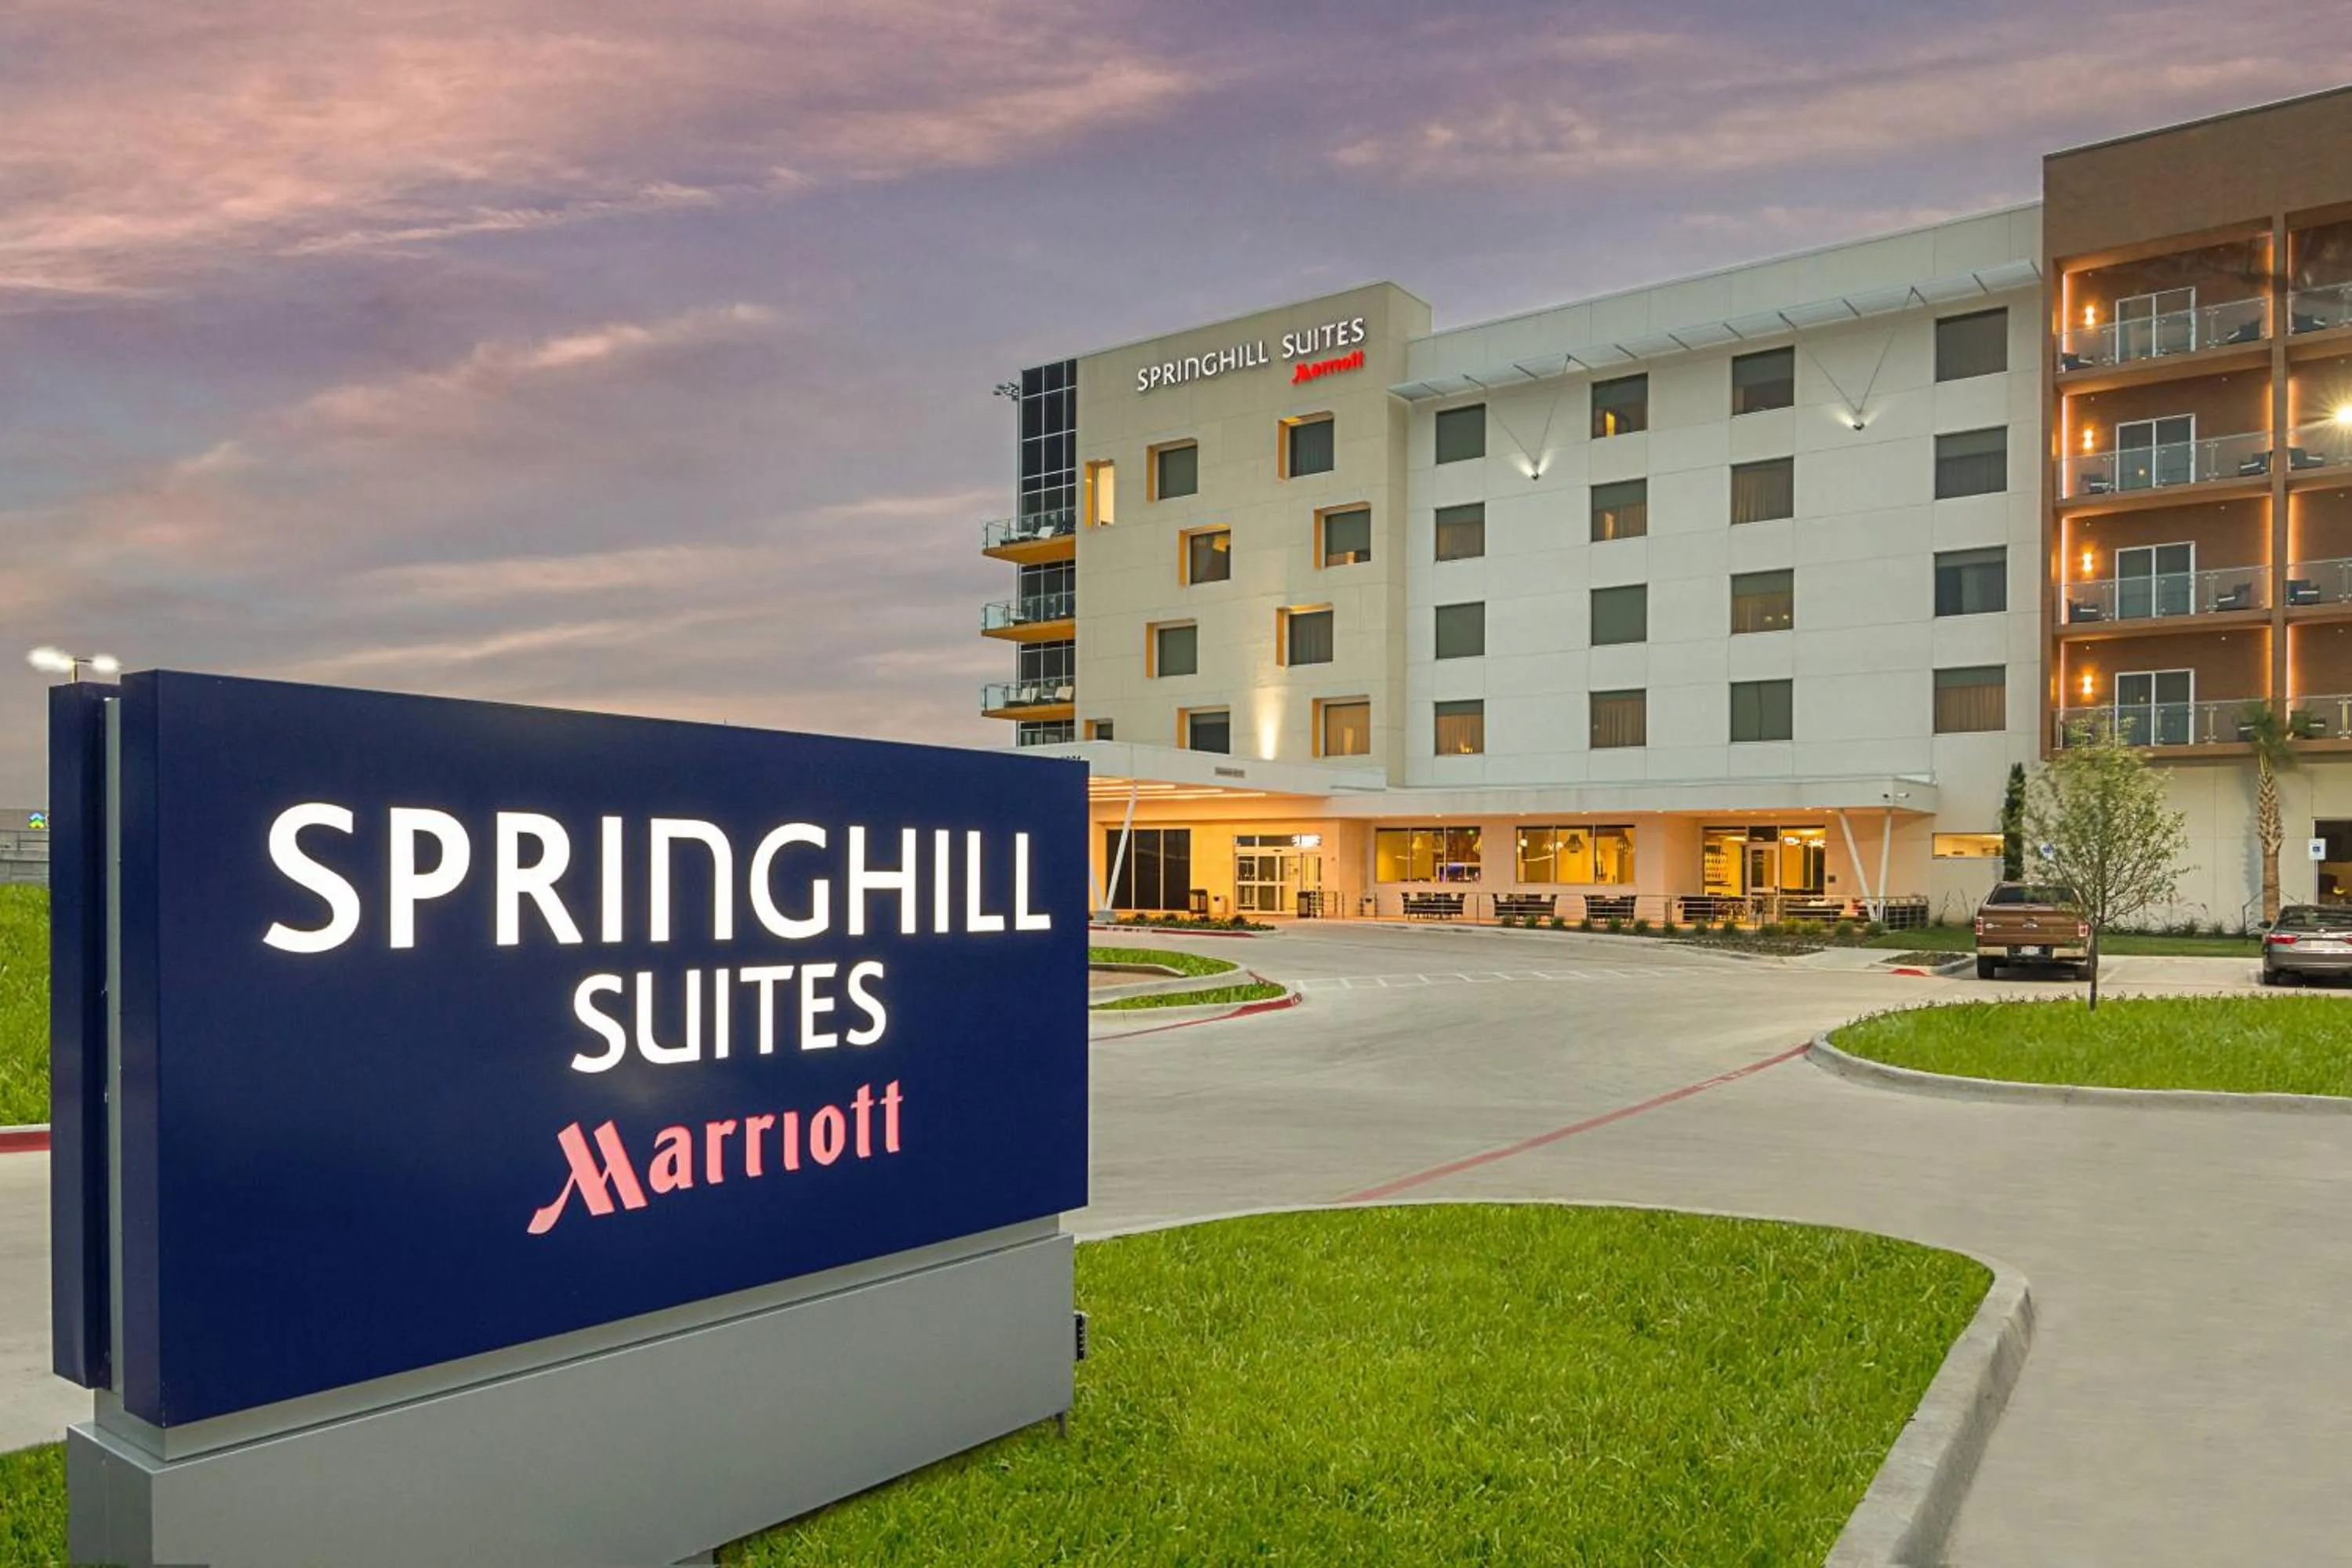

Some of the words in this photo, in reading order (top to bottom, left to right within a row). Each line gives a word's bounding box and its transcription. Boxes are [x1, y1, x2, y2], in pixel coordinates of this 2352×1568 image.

[1137, 340, 1269, 392] SPRINGHILL
[1282, 318, 1365, 359] SUITES
[263, 802, 1051, 953] SPRINGHILL
[571, 960, 887, 1073] SUITES
[527, 1080, 903, 1235] Marriott
